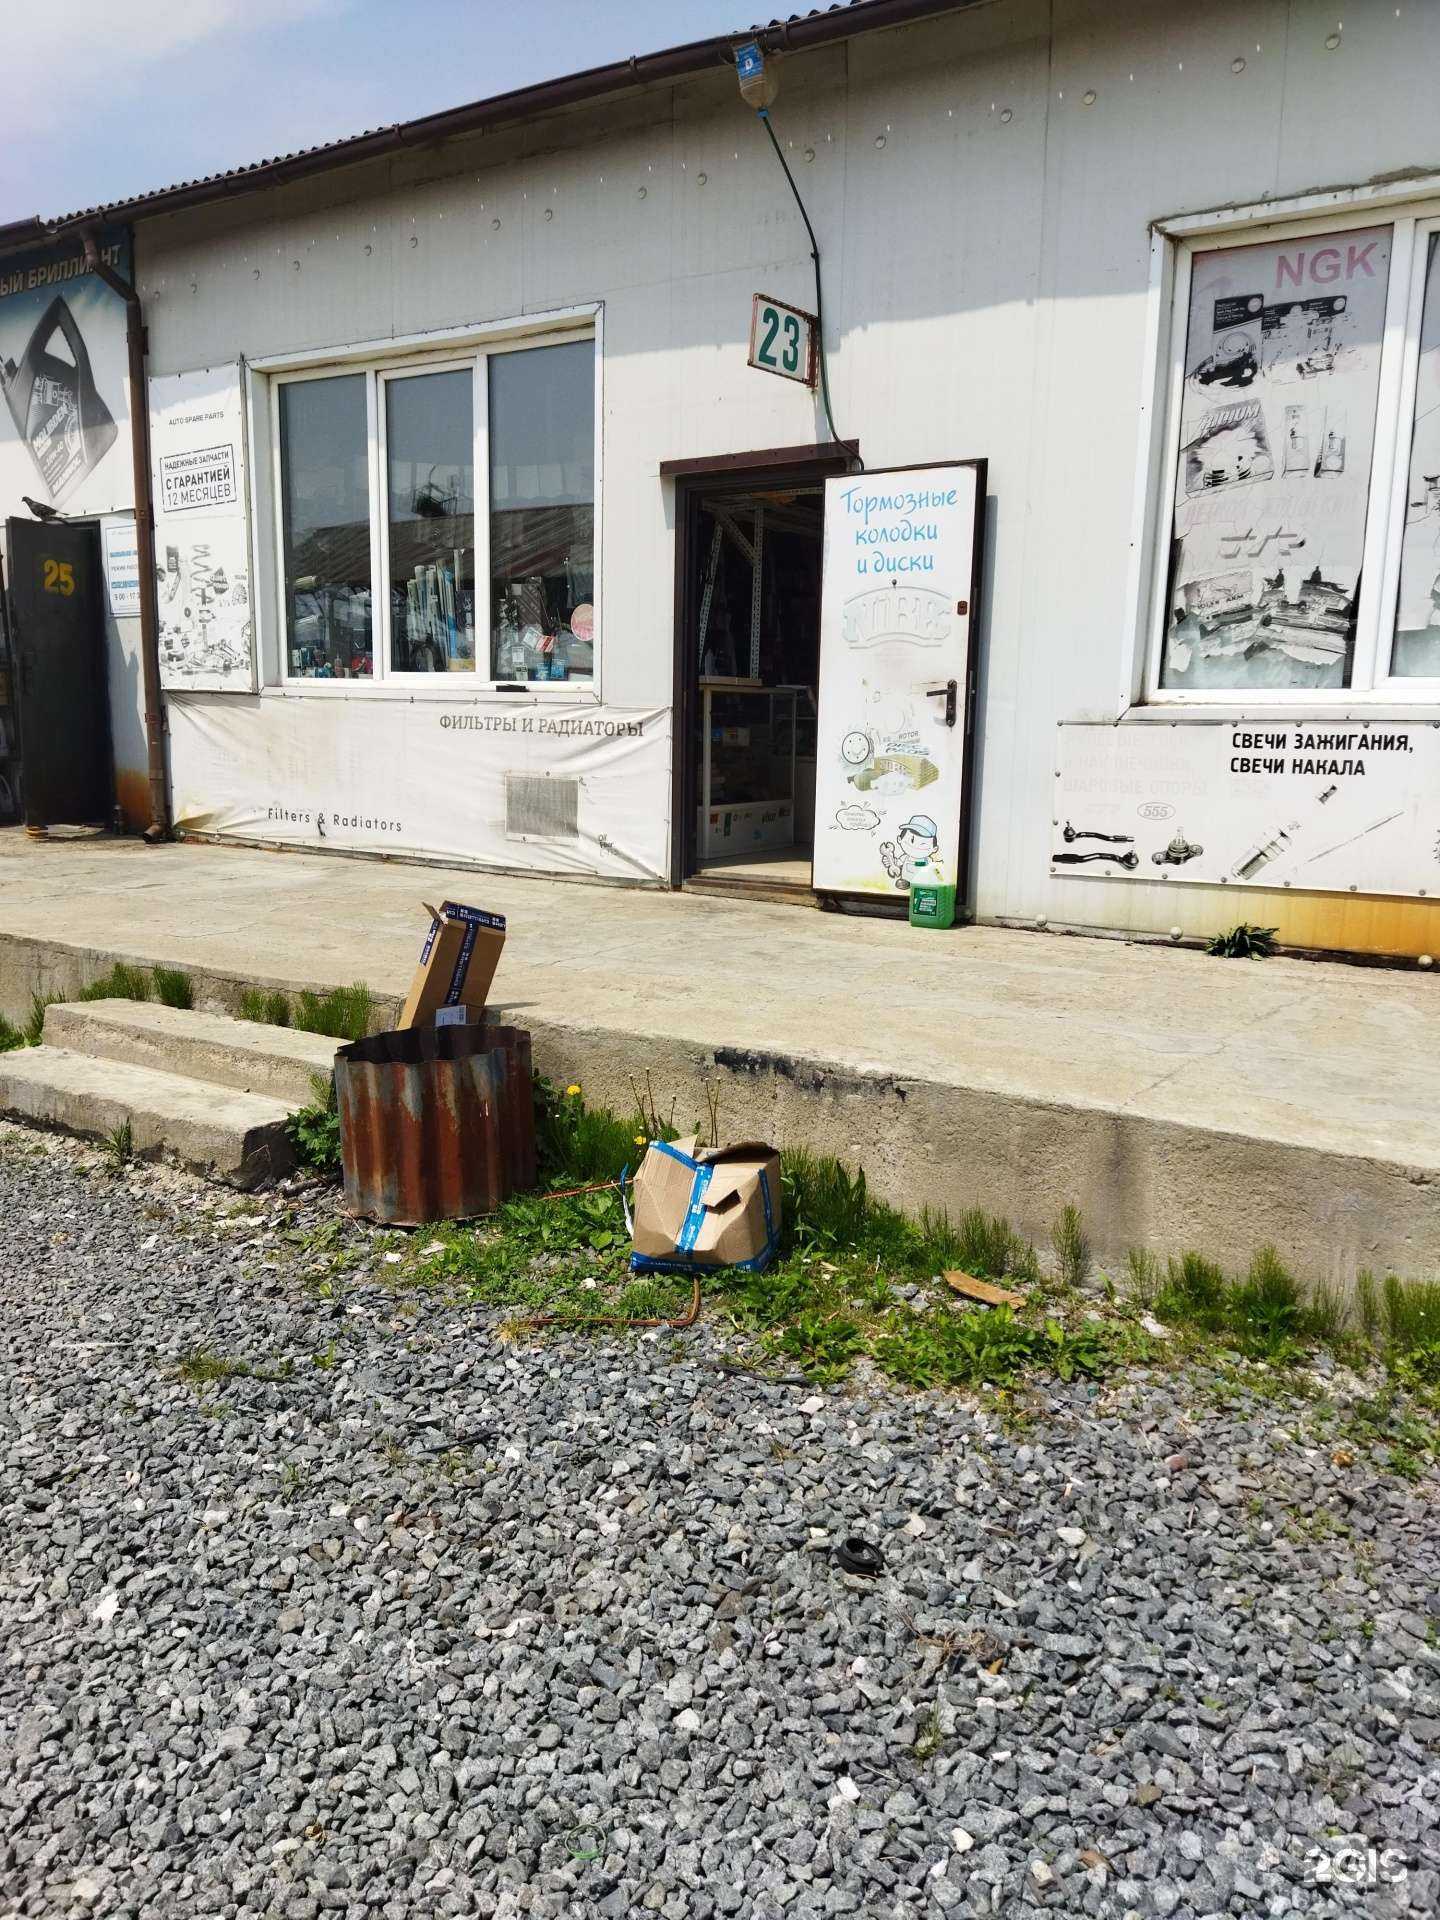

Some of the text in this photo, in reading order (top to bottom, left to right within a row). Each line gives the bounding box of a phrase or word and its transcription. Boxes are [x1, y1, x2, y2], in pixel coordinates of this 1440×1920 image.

[28, 245, 121, 289] БРИЛЛИНТ
[1275, 242, 1378, 289] NGK
[758, 307, 800, 372] 23
[169, 410, 225, 426] AUTO SPARE PARTS
[165, 450, 229, 471] НАДЕЖНЫЕ ЗАПЧАСТИ
[165, 464, 231, 490] С ГАРАНТИЕЙ
[167, 482, 232, 506] 12 МЕСЯЦЕВ
[840, 486, 958, 526] Тормозные
[856, 519, 938, 546] колодки
[857, 550, 934, 574] и диски
[43, 559, 75, 596] 25
[439, 715, 644, 737] ФИЛЬТРЫ И РАДИАТОРЫ
[1232, 732, 1414, 754] СВЕЧИ ЗАЖИГАНИЯ,
[1230, 757, 1366, 776] СВЕЧИ НАКАЛА
[267, 807, 402, 832] Filters & Radiators
[1143, 805, 1169, 818] 555
